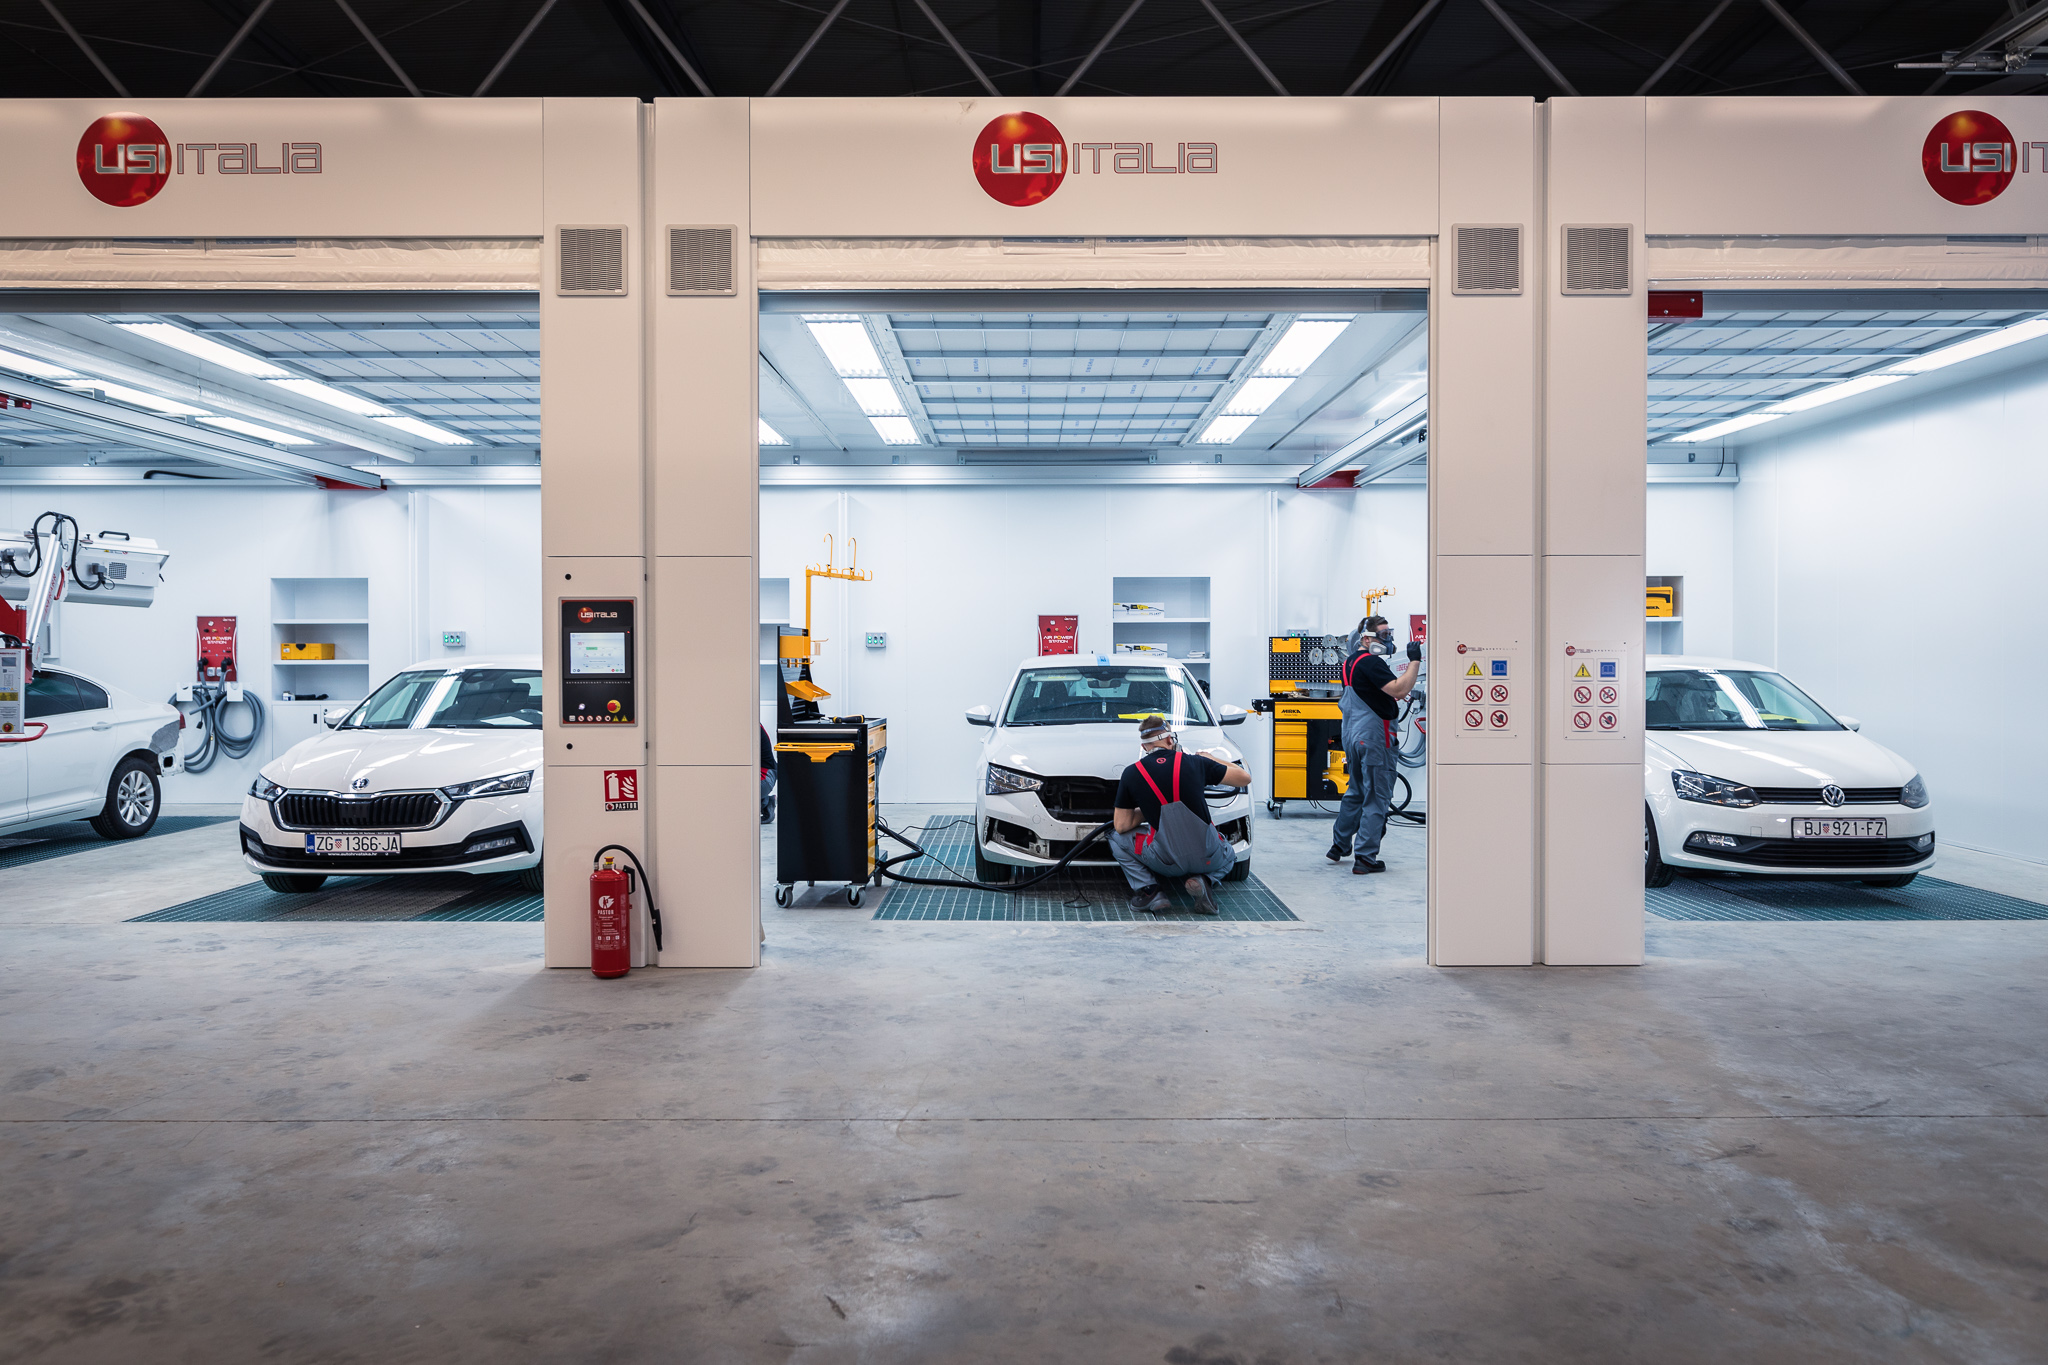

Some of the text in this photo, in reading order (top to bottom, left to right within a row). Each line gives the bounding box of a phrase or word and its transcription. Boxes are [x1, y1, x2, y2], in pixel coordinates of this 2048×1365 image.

[95, 143, 166, 174] USI
[991, 143, 1062, 174] USI
[1941, 142, 2012, 173] USI
[316, 836, 399, 851] ZG 1366-JA
[1804, 821, 1884, 836] BJ 921-FZ
